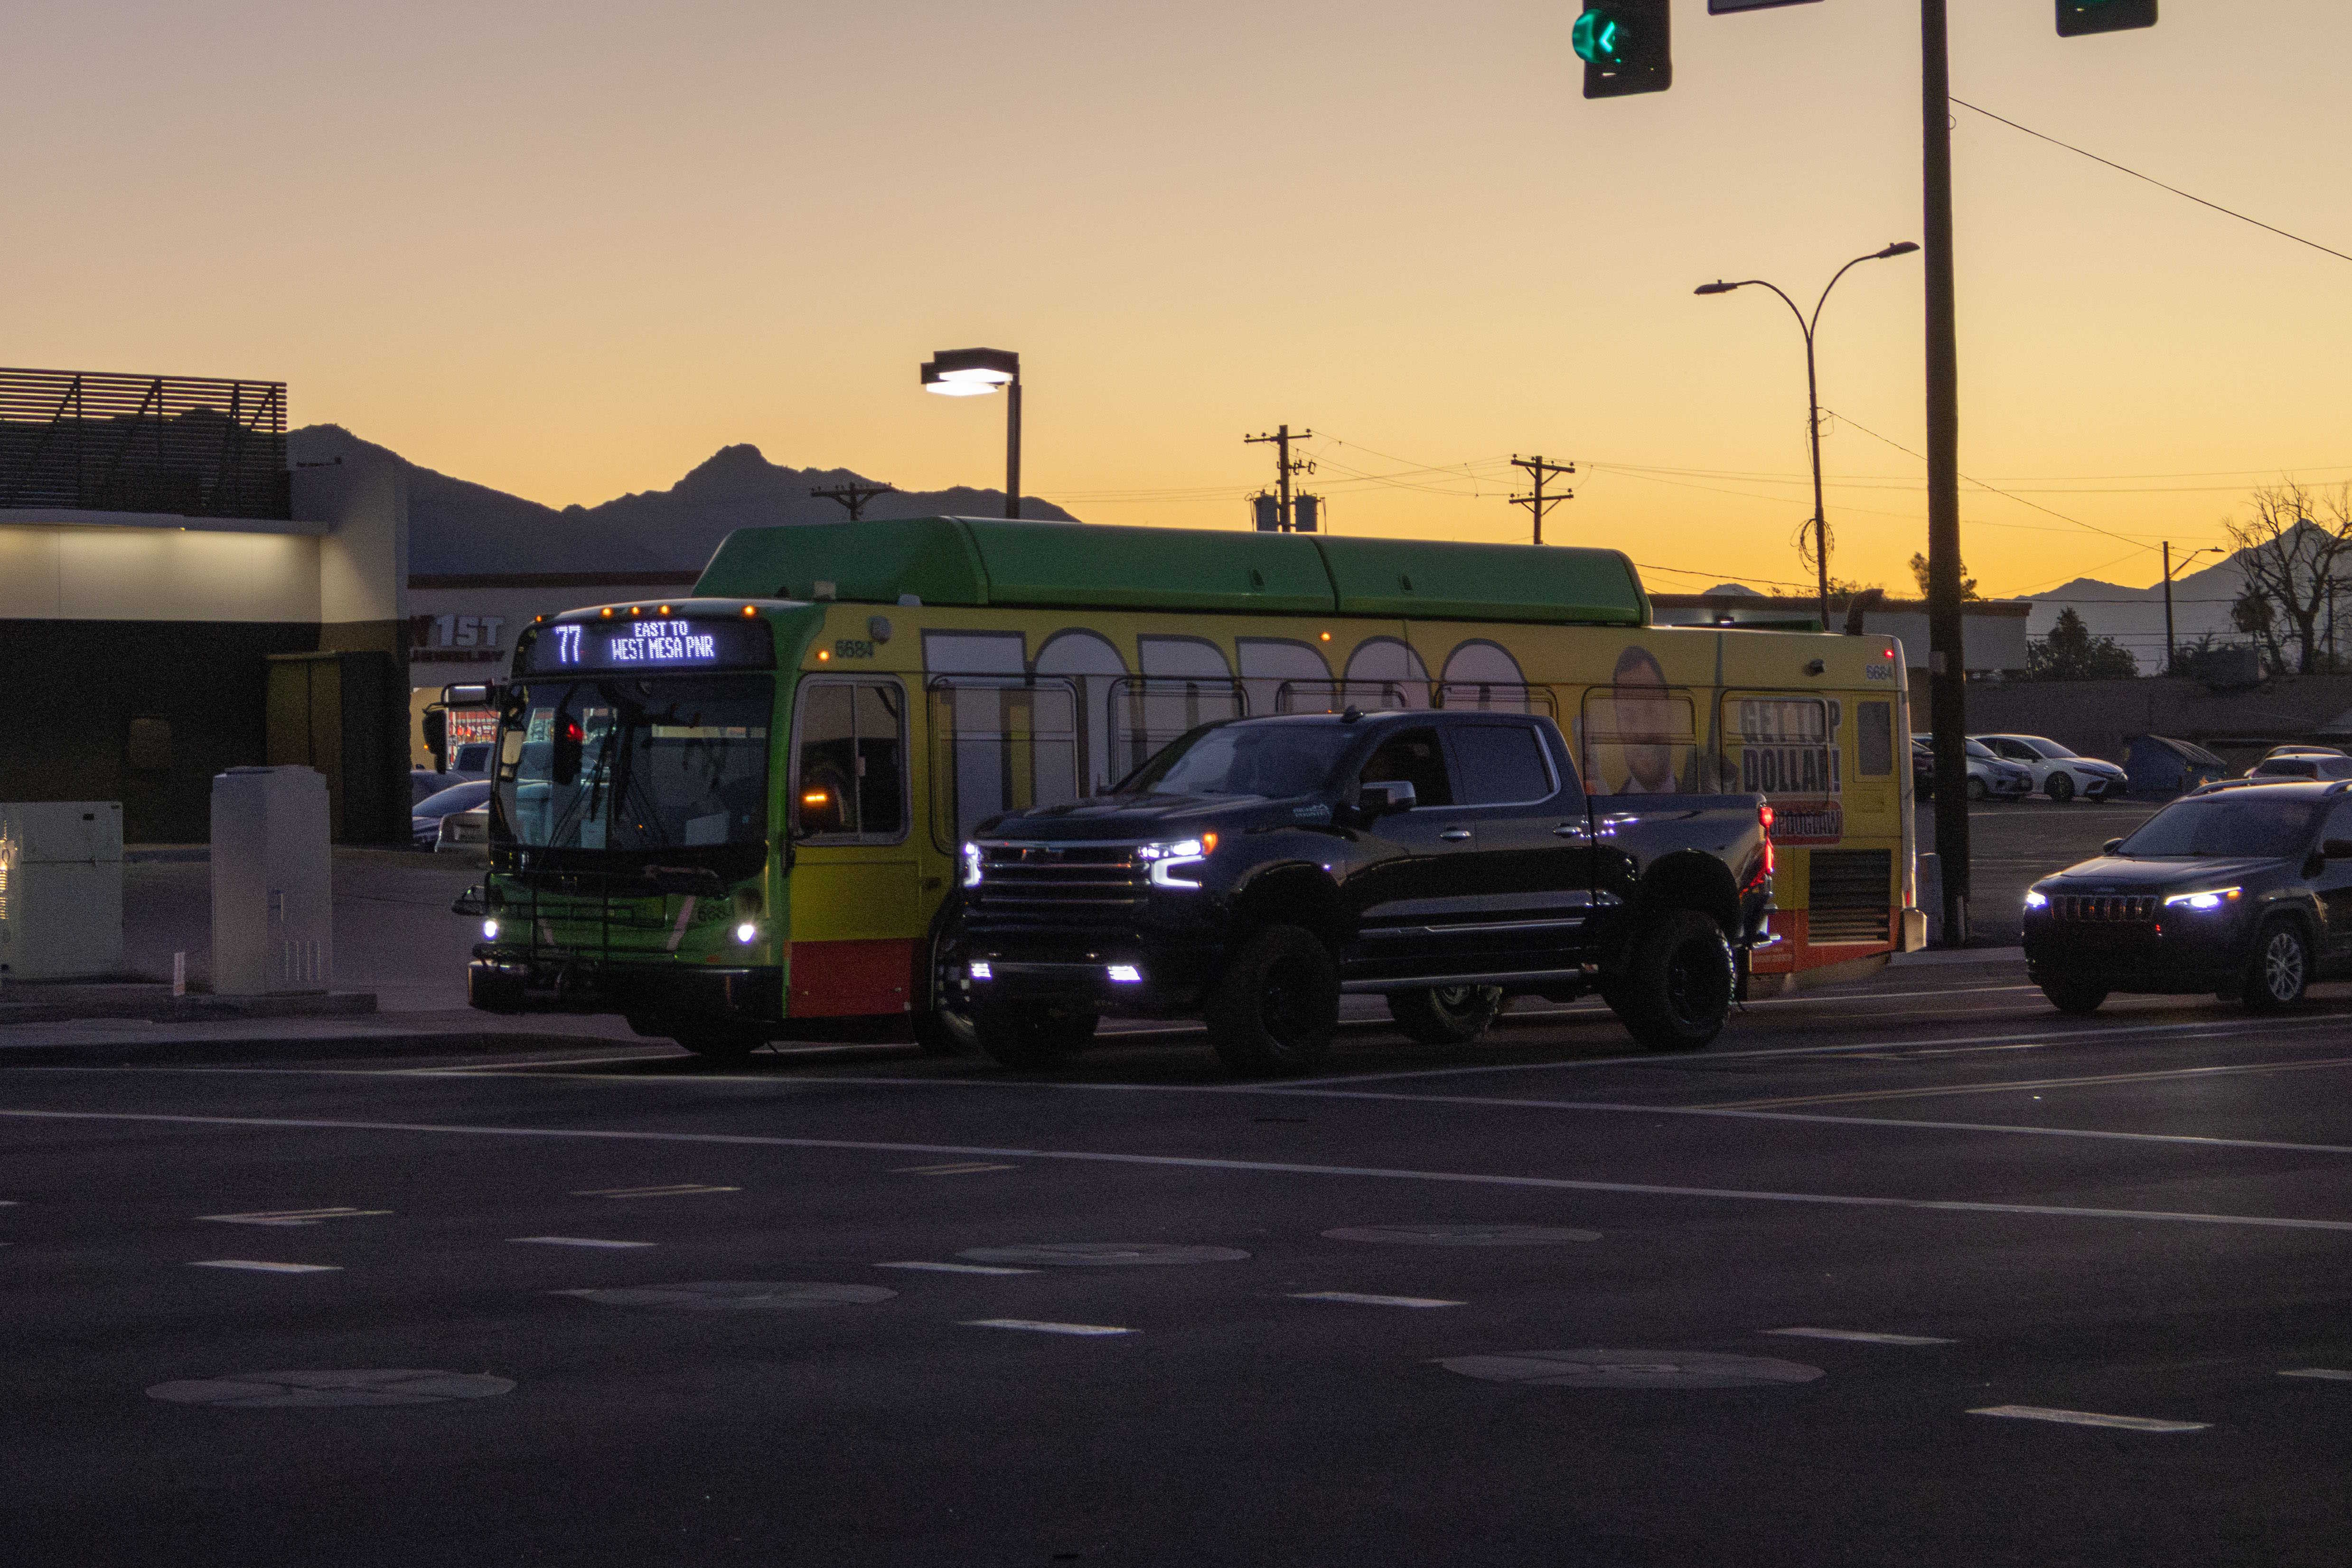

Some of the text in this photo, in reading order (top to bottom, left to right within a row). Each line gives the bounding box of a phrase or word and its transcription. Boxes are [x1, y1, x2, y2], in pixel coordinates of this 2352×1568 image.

[436, 614, 505, 647] 1ST
[555, 625, 581, 662] 77
[634, 621, 688, 637] EAST TO
[611, 635, 715, 659] WEST MESA PNR
[835, 640, 874, 657] 6684
[1740, 700, 1840, 743] GET TOP
[1743, 748, 1839, 792] DOLLAR!
[1770, 810, 1840, 836] OPDOGLAW
